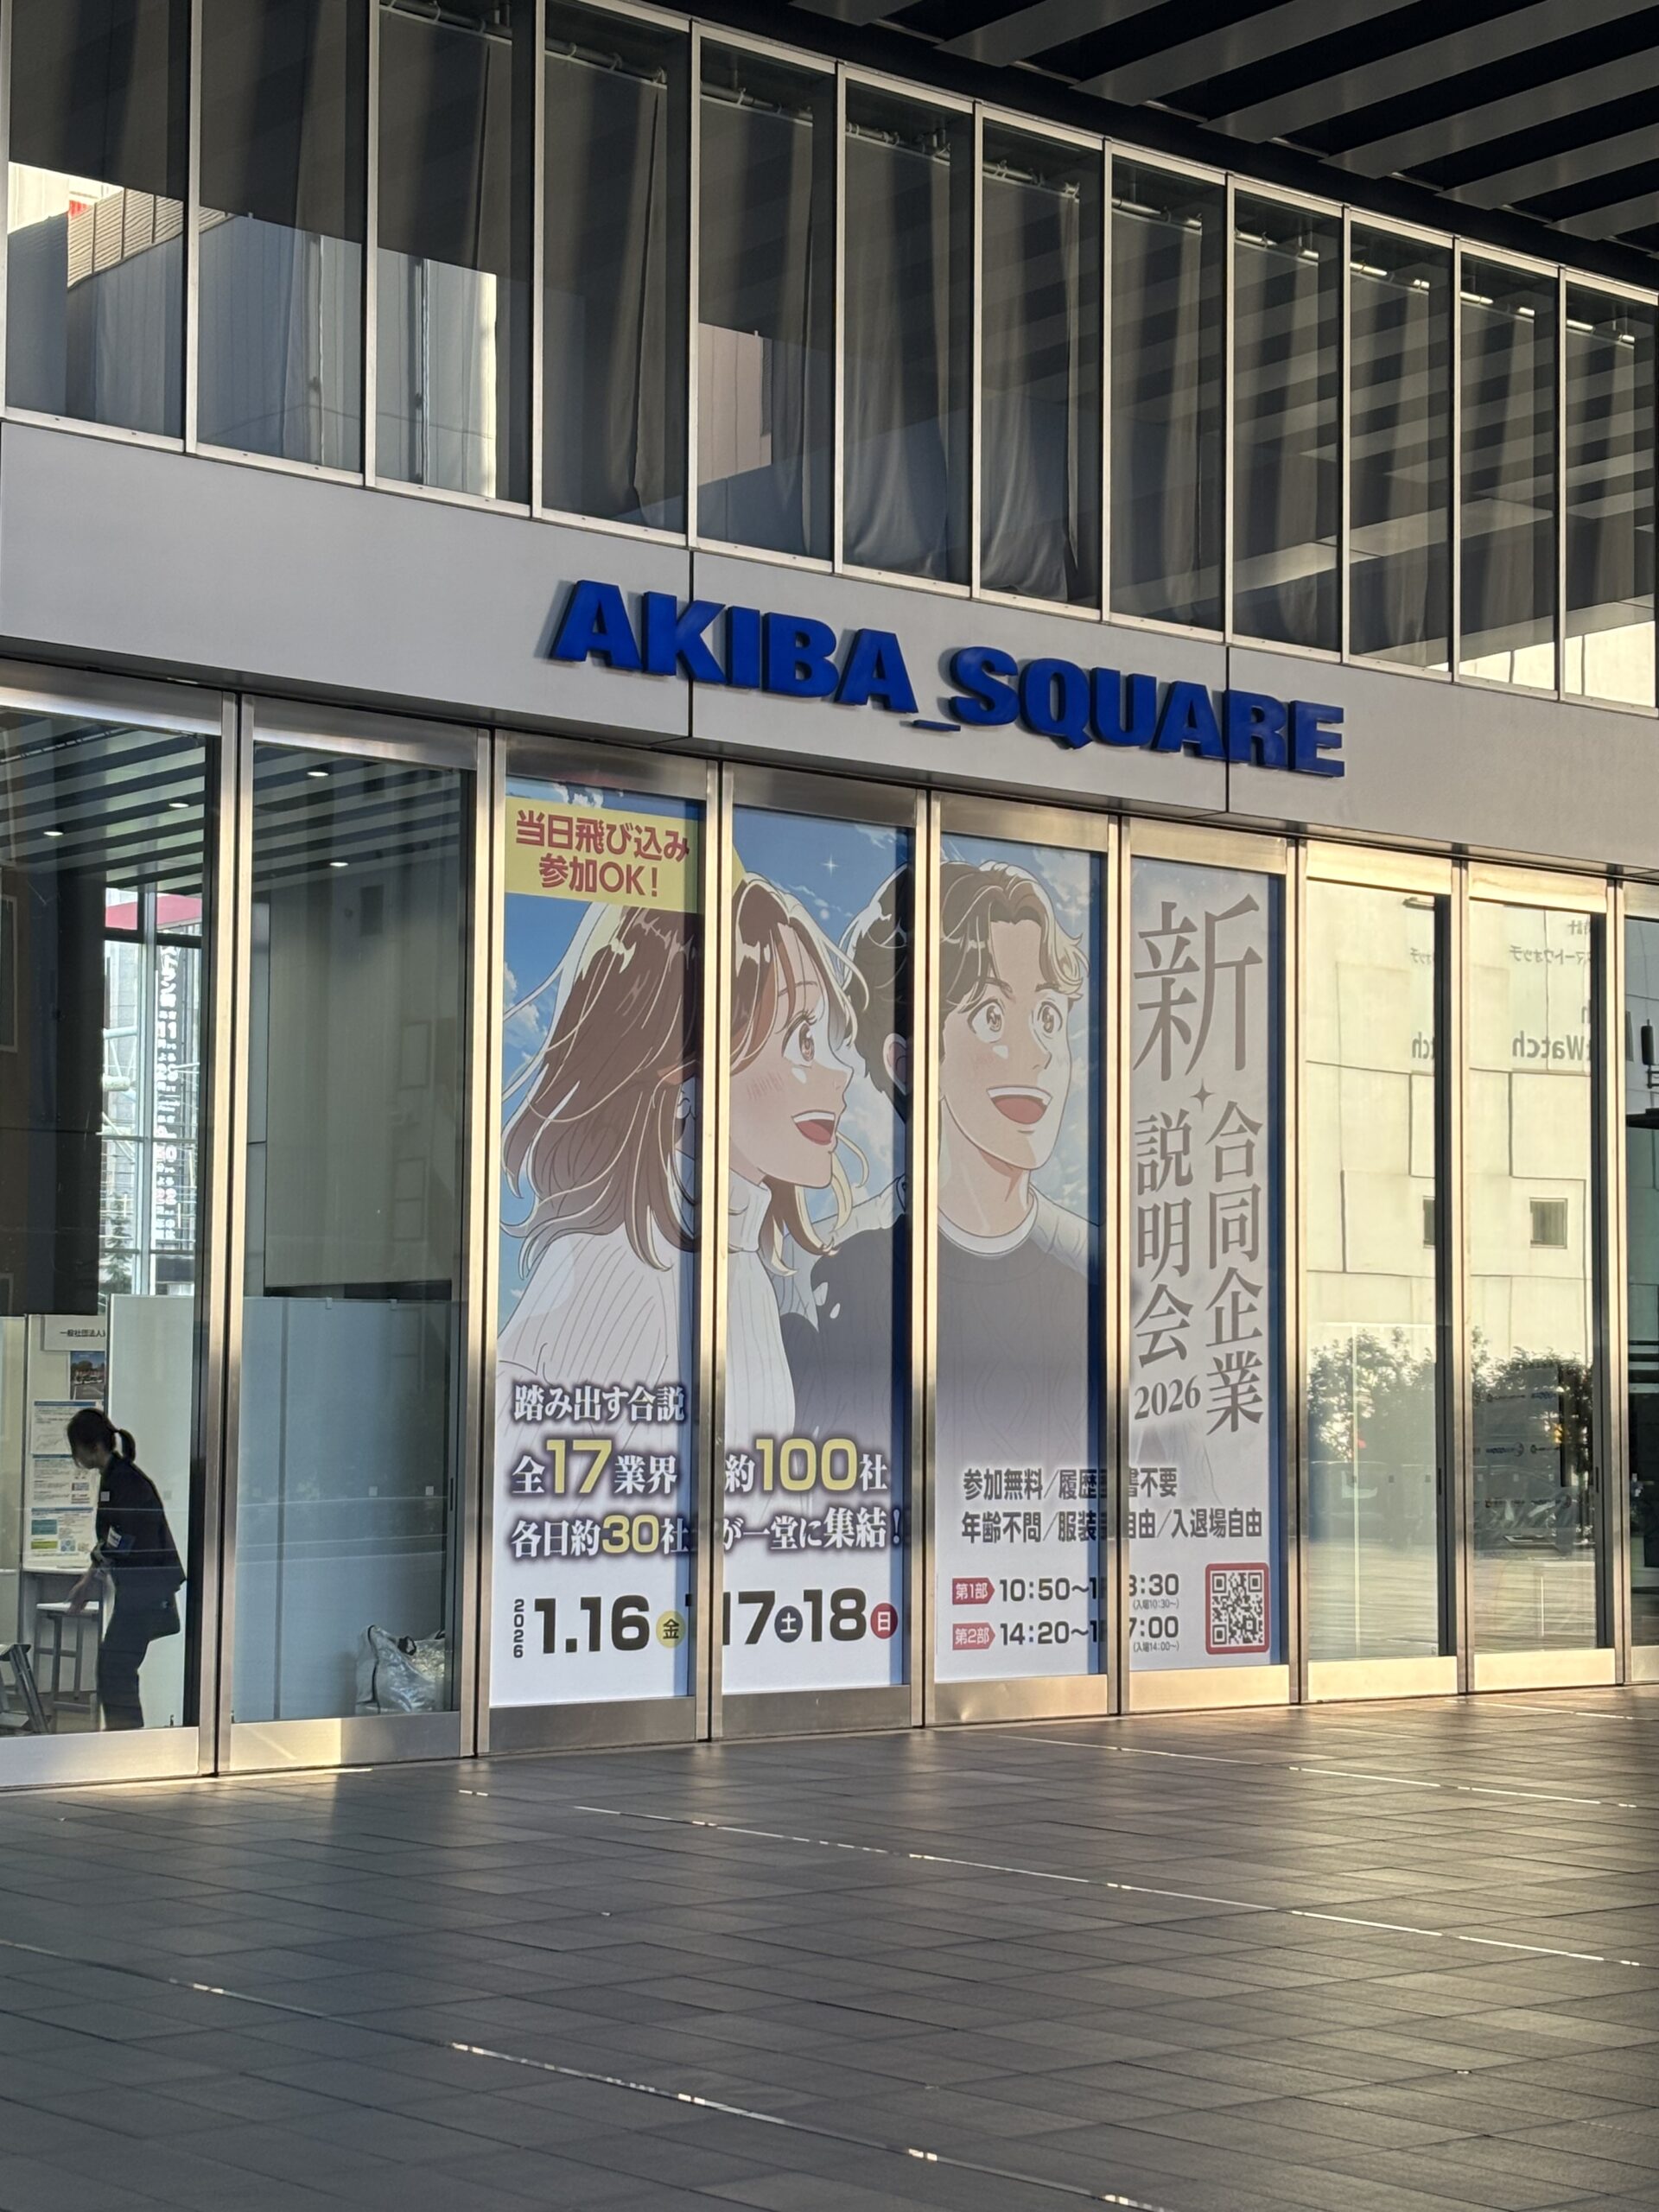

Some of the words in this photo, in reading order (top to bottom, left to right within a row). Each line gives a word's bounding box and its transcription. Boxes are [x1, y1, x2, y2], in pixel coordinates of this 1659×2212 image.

[516, 810, 690, 862] 当日飛び込み
[539, 853, 658, 897] 参加OK!
[1134, 893, 1263, 1082] 新
[1134, 1108, 1194, 1369] 説明会
[1205, 1100, 1264, 1435] 合同企業
[513, 1385, 685, 1421] 踏み出す合説
[1135, 1374, 1202, 1420] 2026
[512, 1440, 677, 1494] 全17業界
[724, 1439, 887, 1492] 約100社
[512, 1514, 690, 1557] 各日約30社
[955, 1583, 988, 1600] 第1部
[513, 1599, 525, 1658] 2026
[534, 1594, 650, 1654] 1.16
[662, 1618, 680, 1640] 金
[780, 1612, 797, 1633] 土
[804, 1587, 866, 1642] 18
[878, 1611, 892, 1631] 日
[955, 1627, 990, 1645] 第2部
